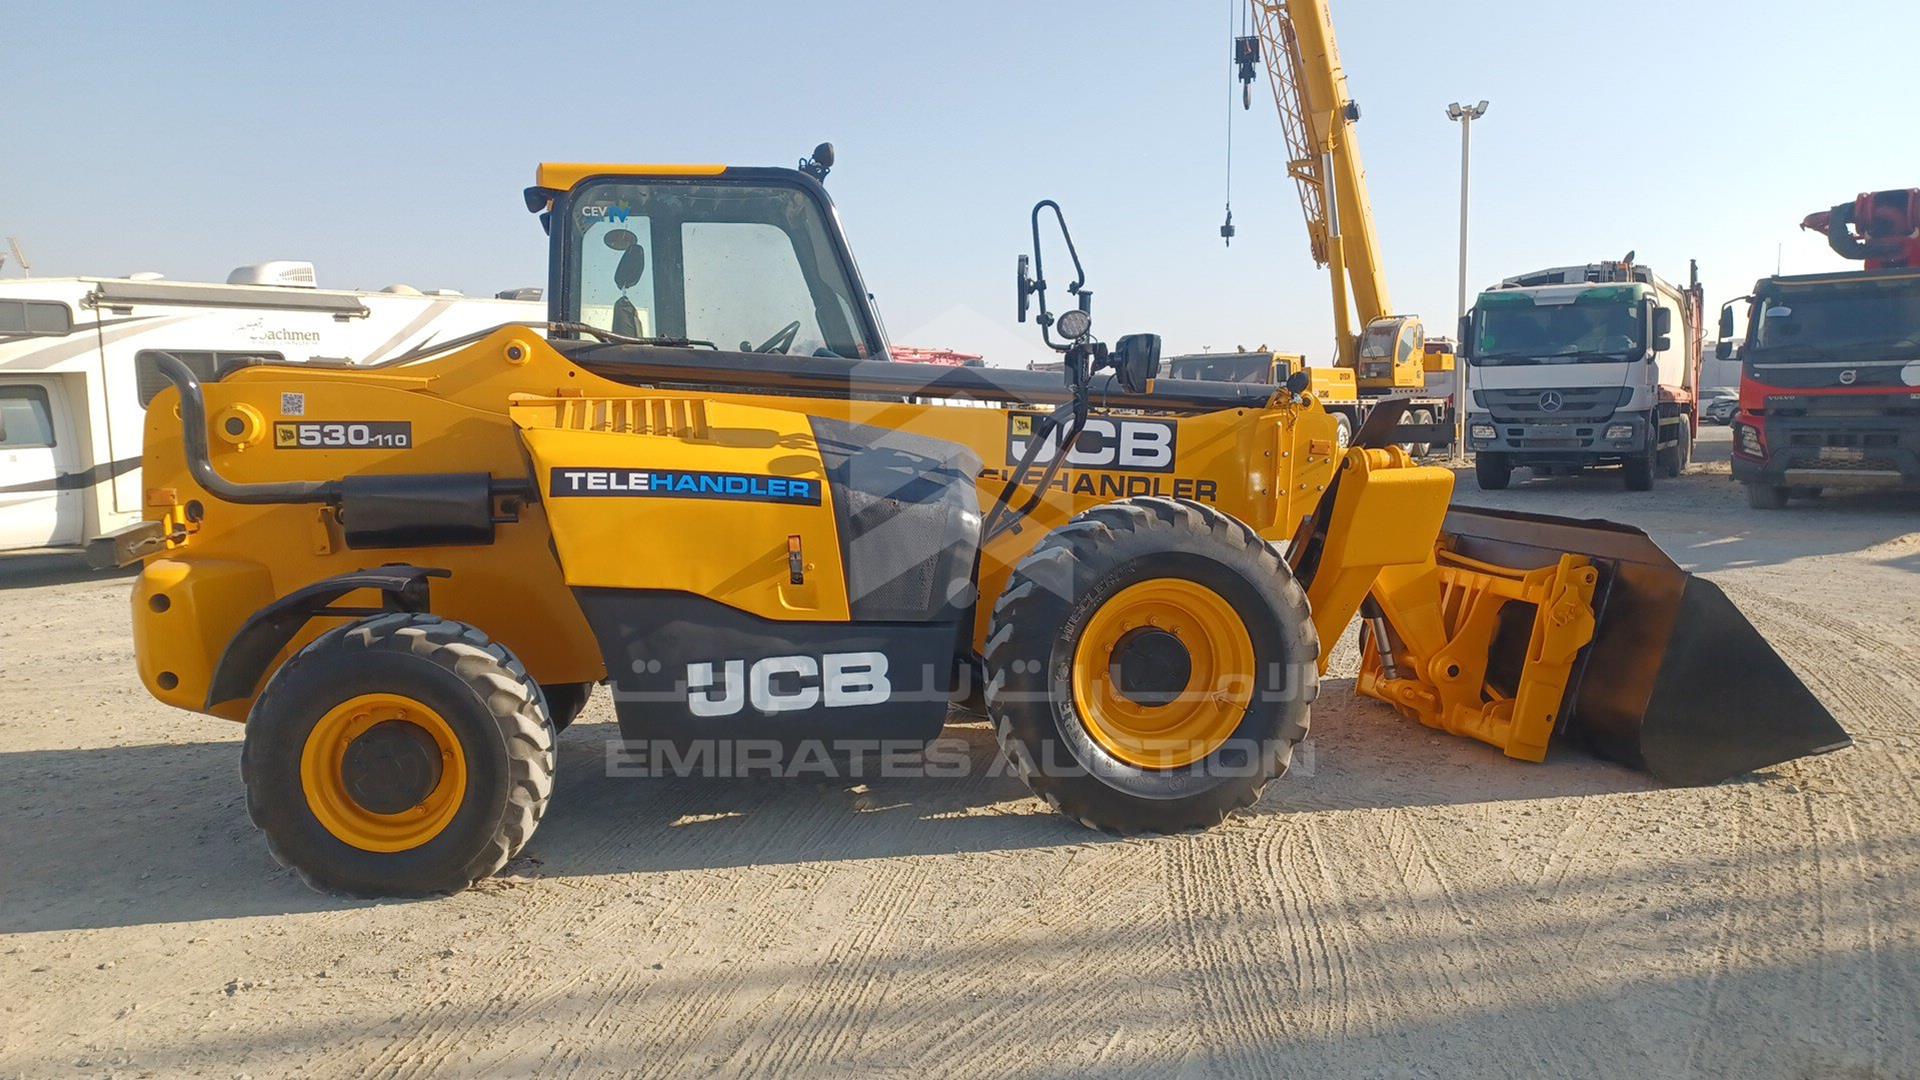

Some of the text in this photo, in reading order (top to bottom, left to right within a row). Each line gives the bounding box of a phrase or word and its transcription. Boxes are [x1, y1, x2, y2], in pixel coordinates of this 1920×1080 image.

[582, 206, 607, 217] CEV
[249, 328, 320, 341] oachmen
[299, 424, 408, 446] 530-110
[1012, 417, 1173, 468] JCB
[564, 472, 810, 498] TELEHANDLER
[687, 652, 892, 717] JCB
